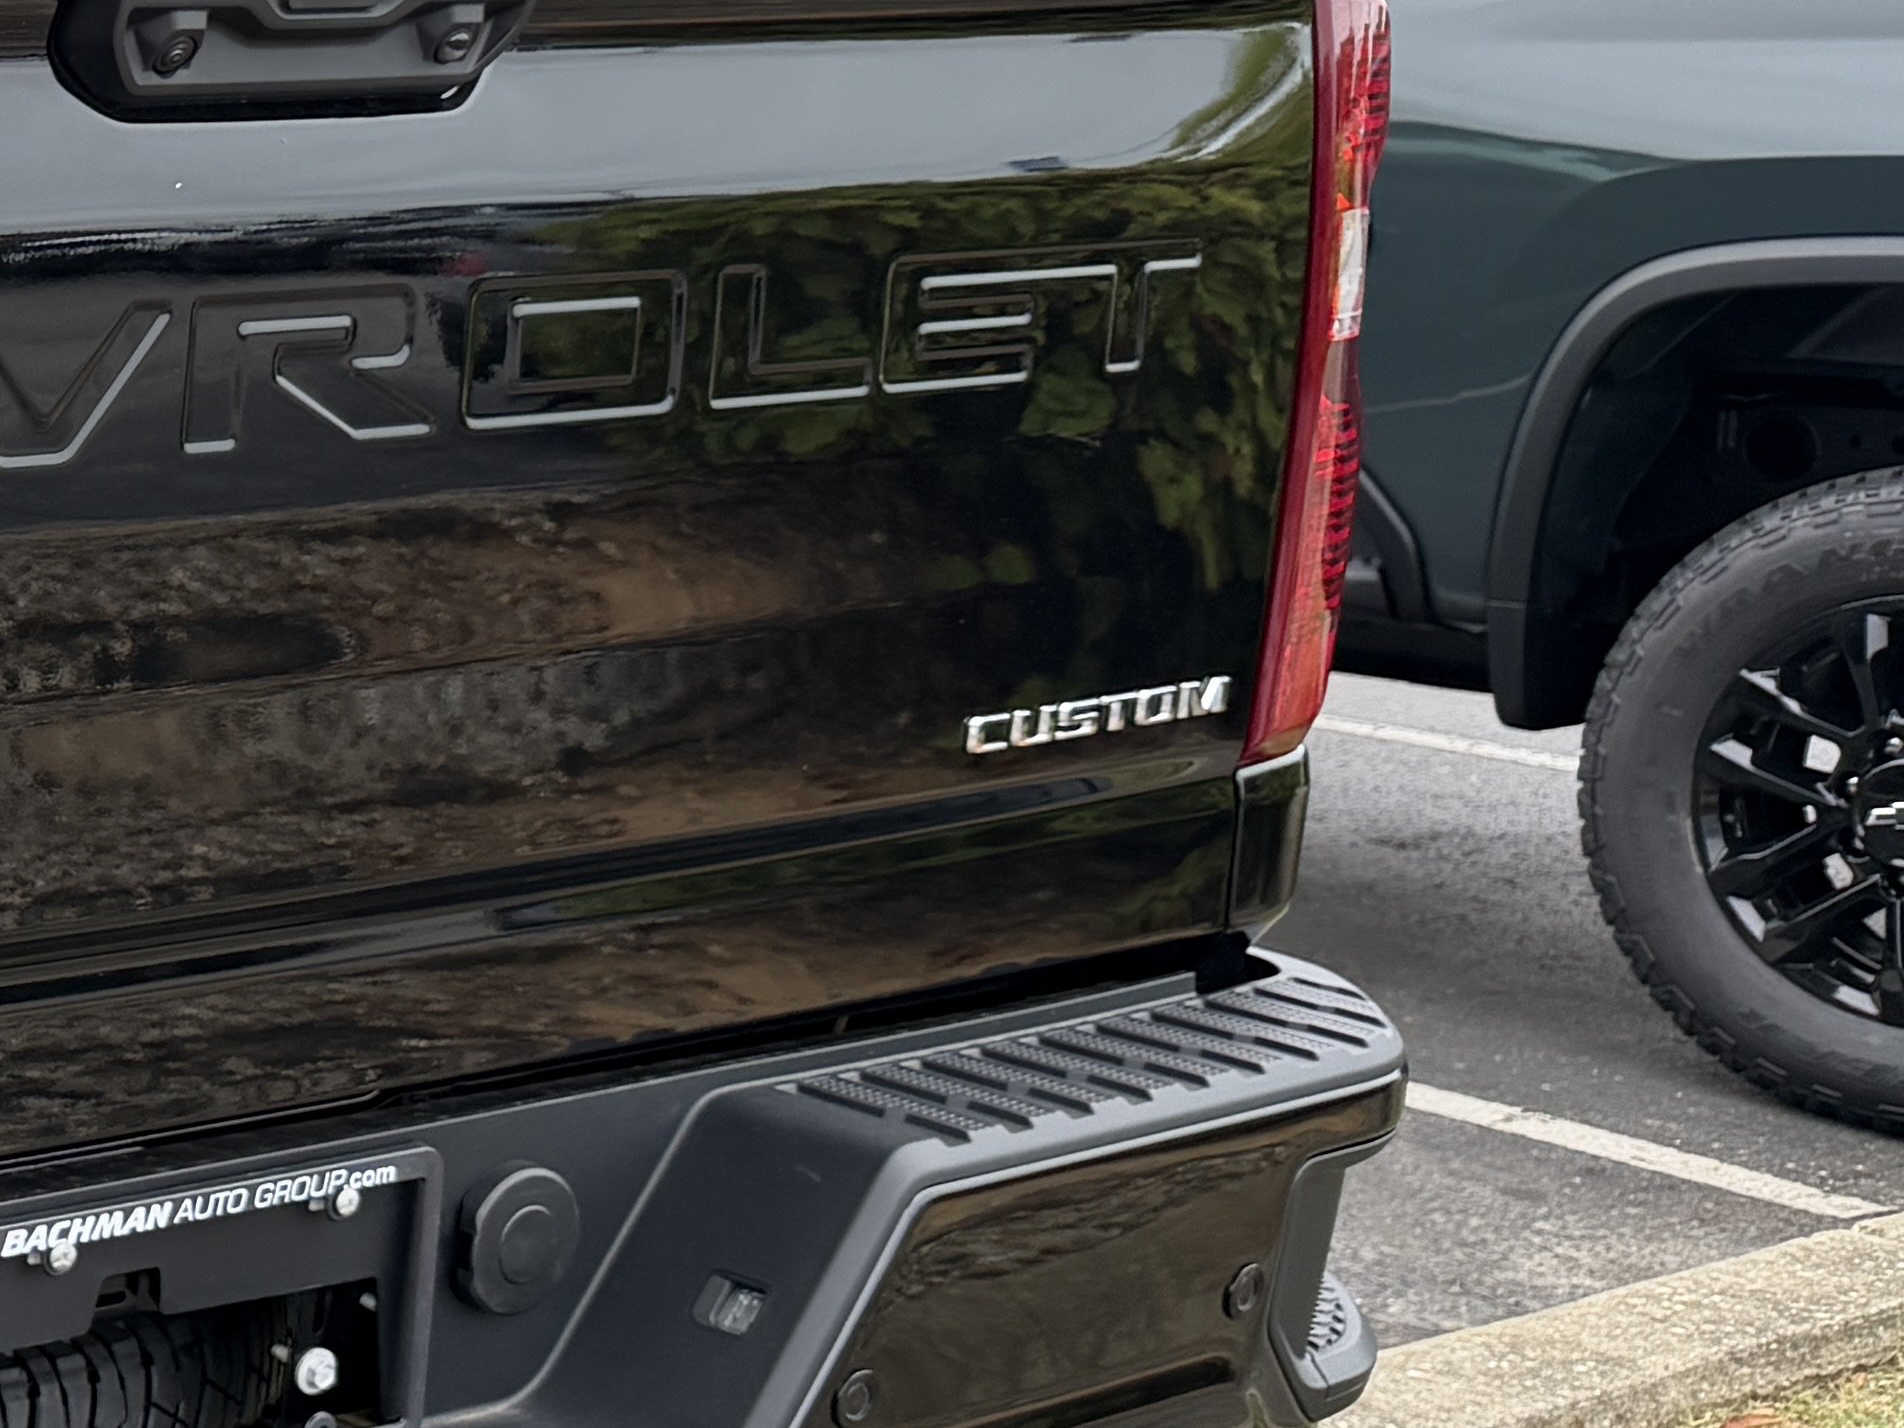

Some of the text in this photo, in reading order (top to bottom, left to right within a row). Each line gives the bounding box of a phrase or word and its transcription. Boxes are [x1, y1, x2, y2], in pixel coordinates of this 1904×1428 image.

[963, 675, 1232, 755] CUSTOM
[0, 1200, 174, 1258] BACHMAN
[173, 1187, 249, 1225] AUTO
